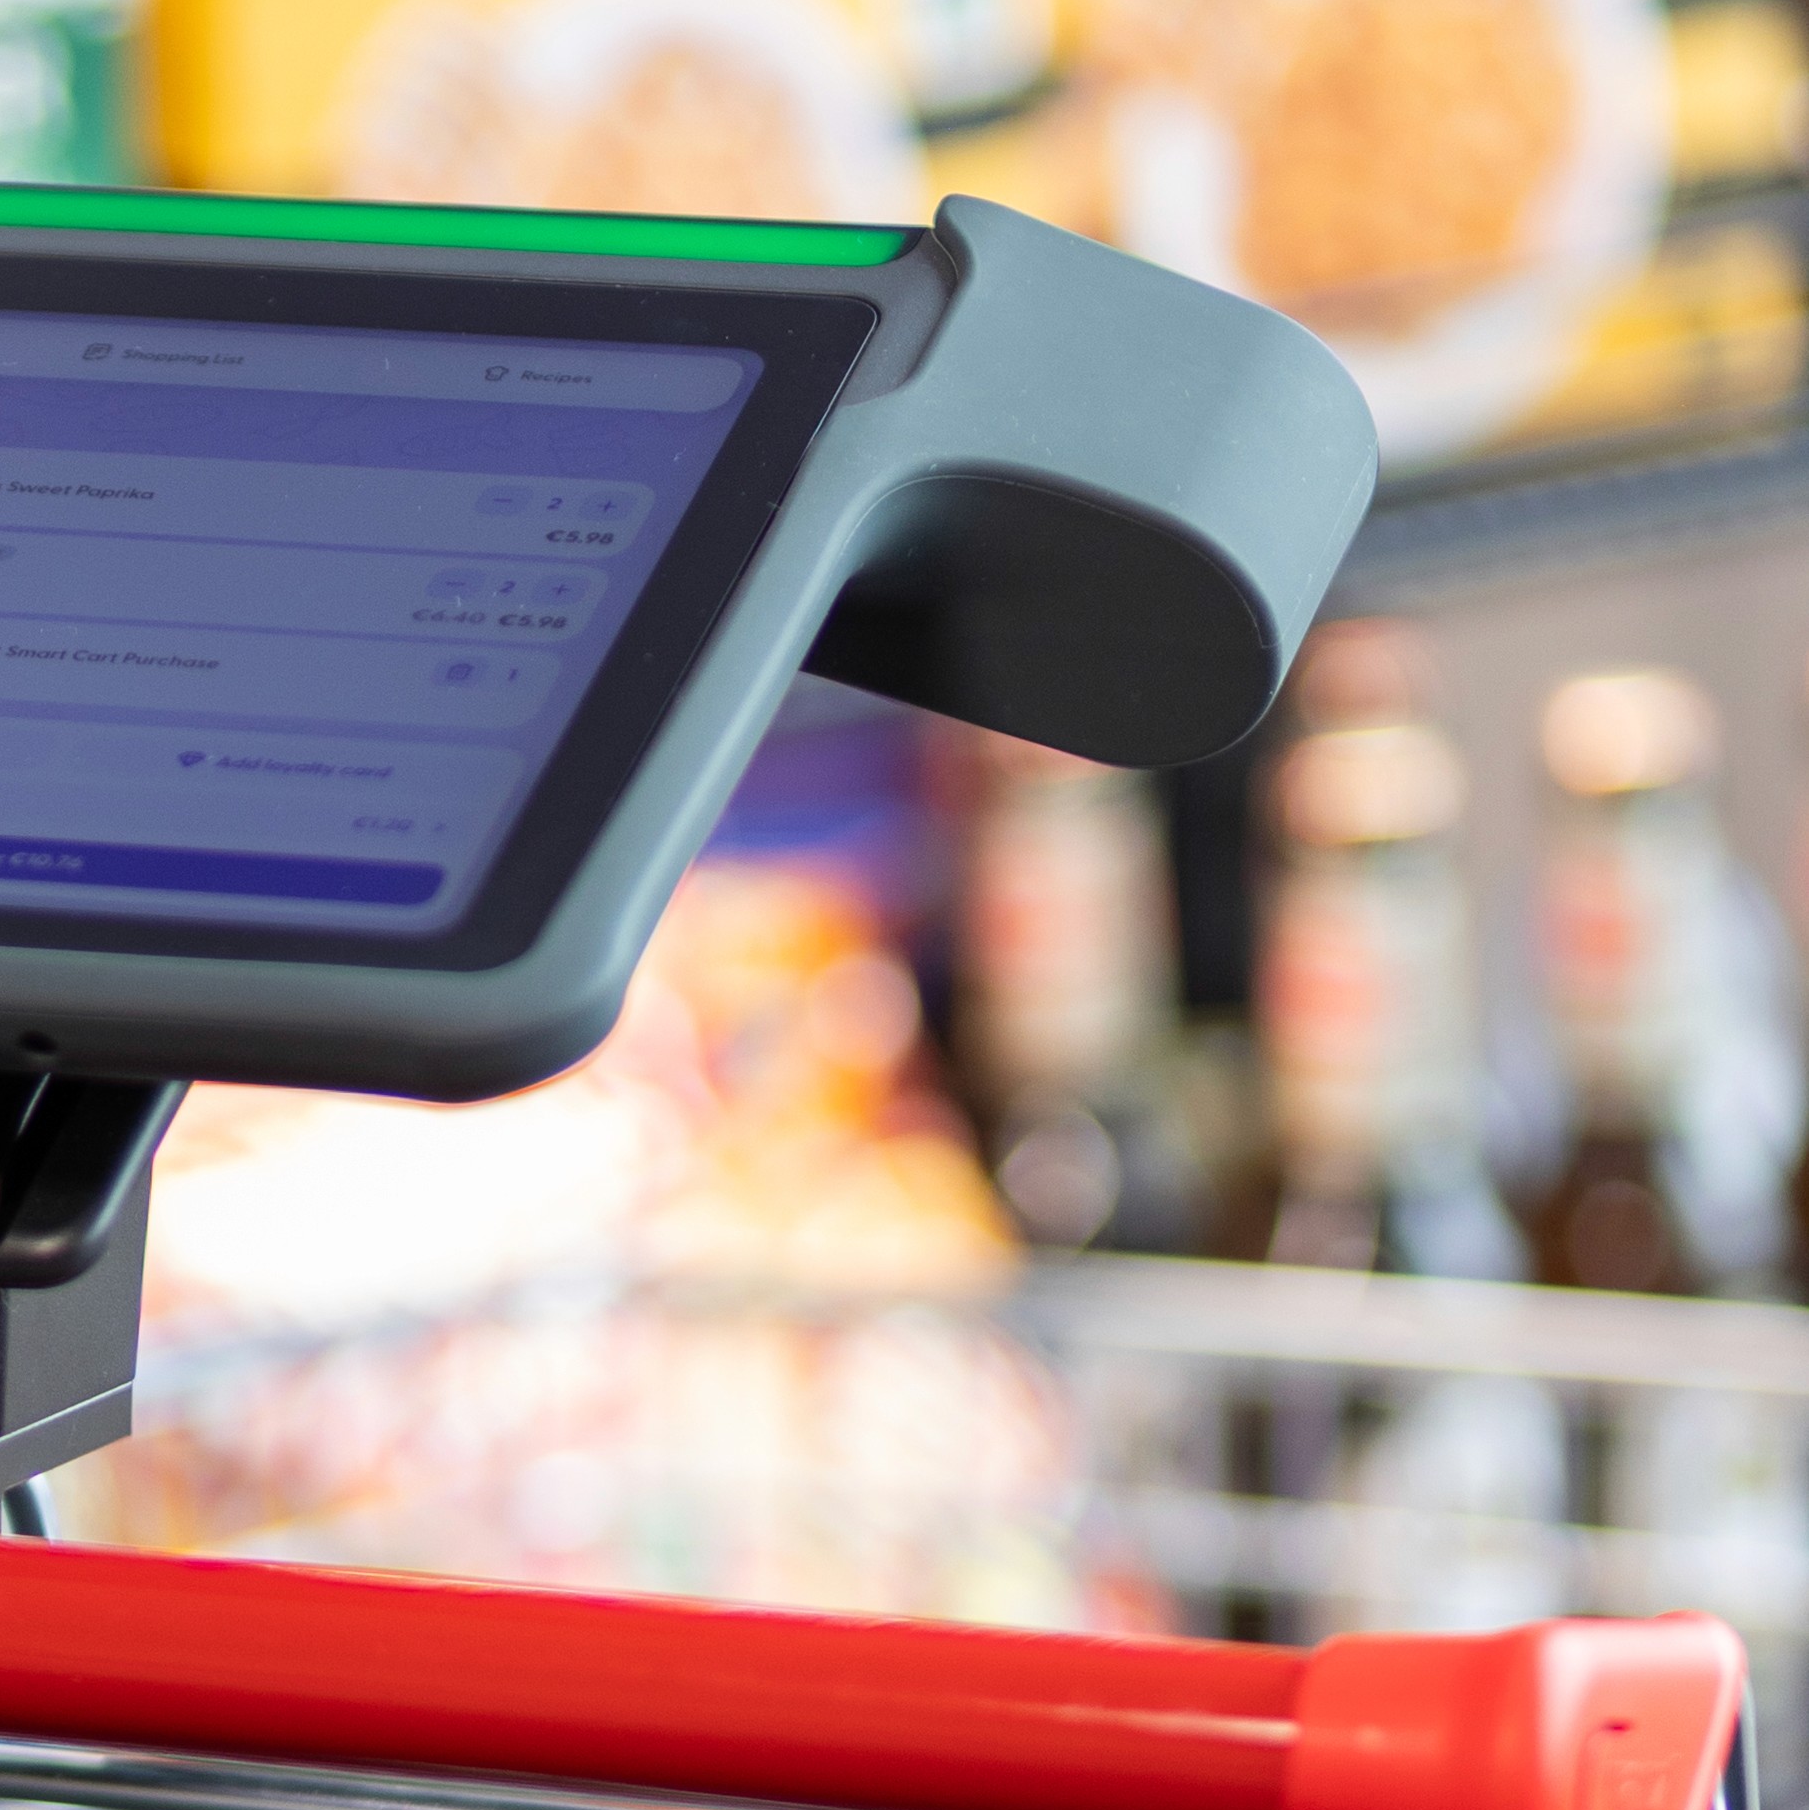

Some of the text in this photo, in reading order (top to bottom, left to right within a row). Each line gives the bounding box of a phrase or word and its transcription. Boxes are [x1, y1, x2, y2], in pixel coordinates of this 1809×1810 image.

[122, 347, 244, 366] Shopping List
[521, 369, 592, 386] Recipes
[8, 480, 73, 496] Sweet
[75, 484, 155, 502] Paprika
[547, 497, 563, 511] 2
[546, 529, 615, 545] €5.98
[499, 580, 516, 594] 2
[498, 614, 568, 629] €5.98
[6, 644, 67, 661] Smart
[72, 649, 119, 664] Cart
[121, 652, 220, 670] Purchase
[214, 755, 394, 779] Add loyalty card
